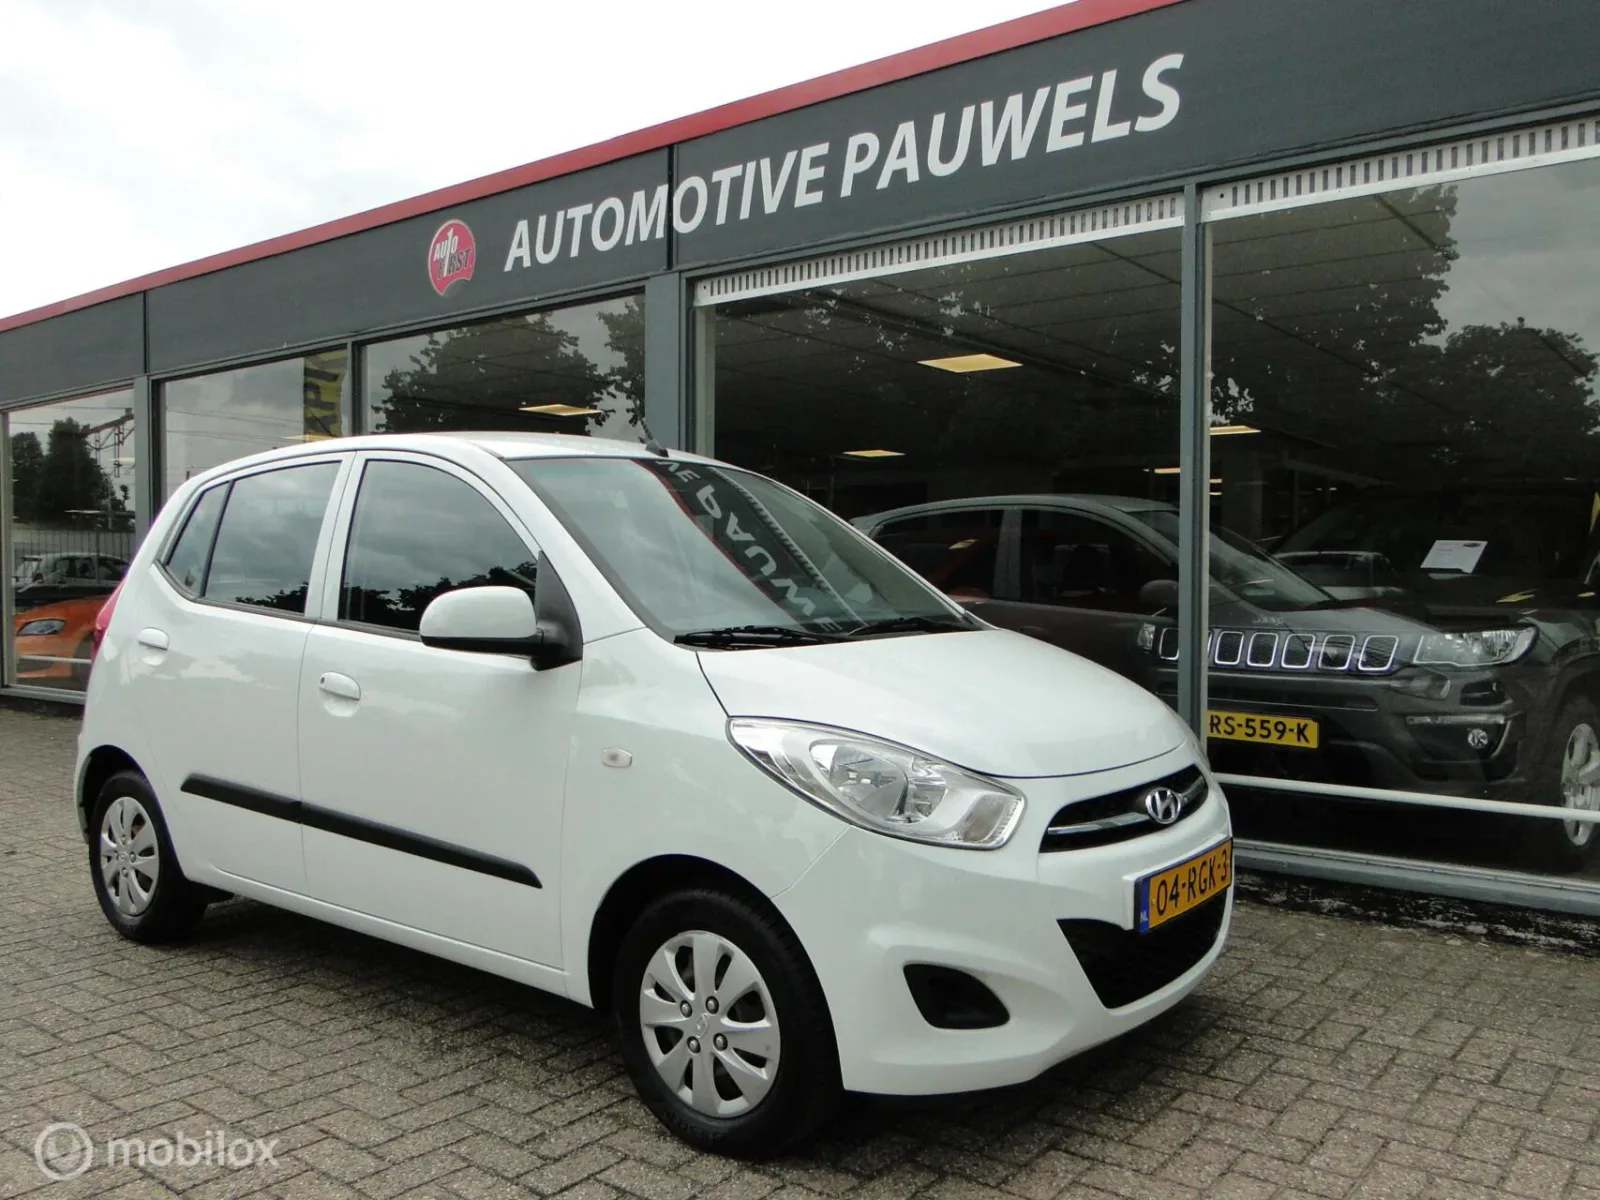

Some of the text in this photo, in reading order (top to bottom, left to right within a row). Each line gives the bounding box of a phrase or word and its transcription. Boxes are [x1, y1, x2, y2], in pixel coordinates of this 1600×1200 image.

[503, 53, 1185, 272] AUTOMOTIVE PAUWELS
[1209, 714, 1310, 744] RS-559-K
[1156, 849, 1229, 917] 04-RGK-3
